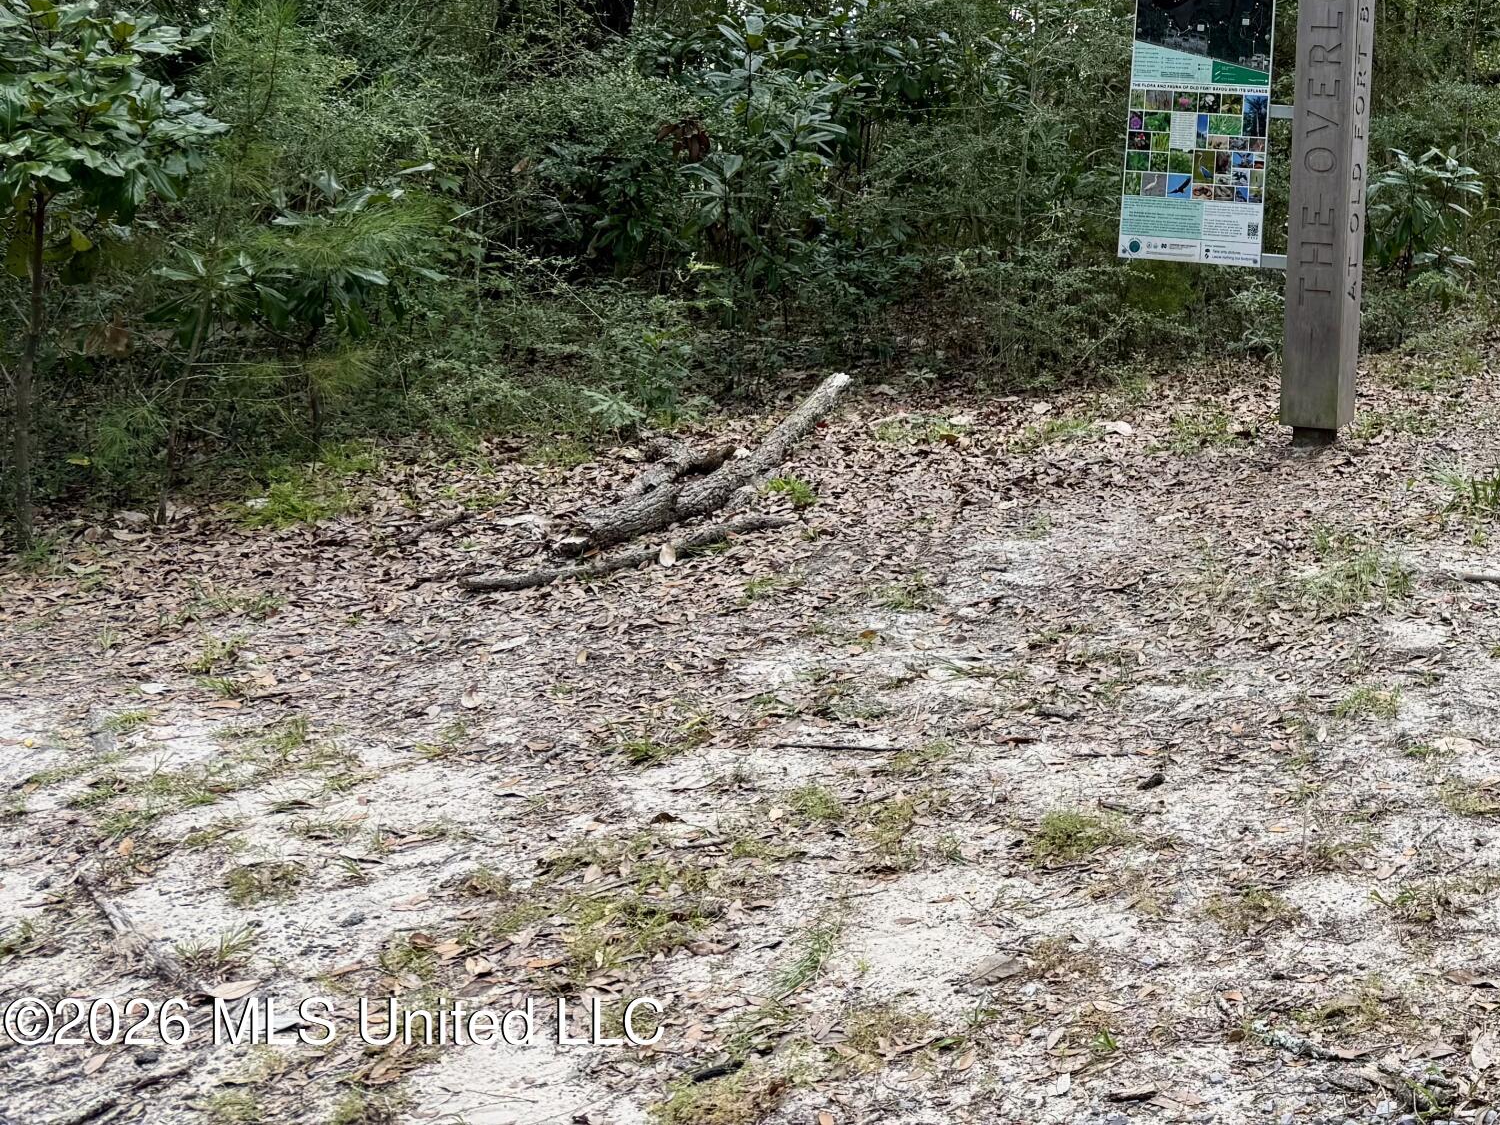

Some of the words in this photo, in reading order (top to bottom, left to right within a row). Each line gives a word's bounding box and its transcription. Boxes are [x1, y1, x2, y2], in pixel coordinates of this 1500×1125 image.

[1354, 50, 1368, 140] FORT
[1350, 163, 1362, 233] OLD
[1299, 206, 1335, 307] THE
[1347, 256, 1358, 301] AT
